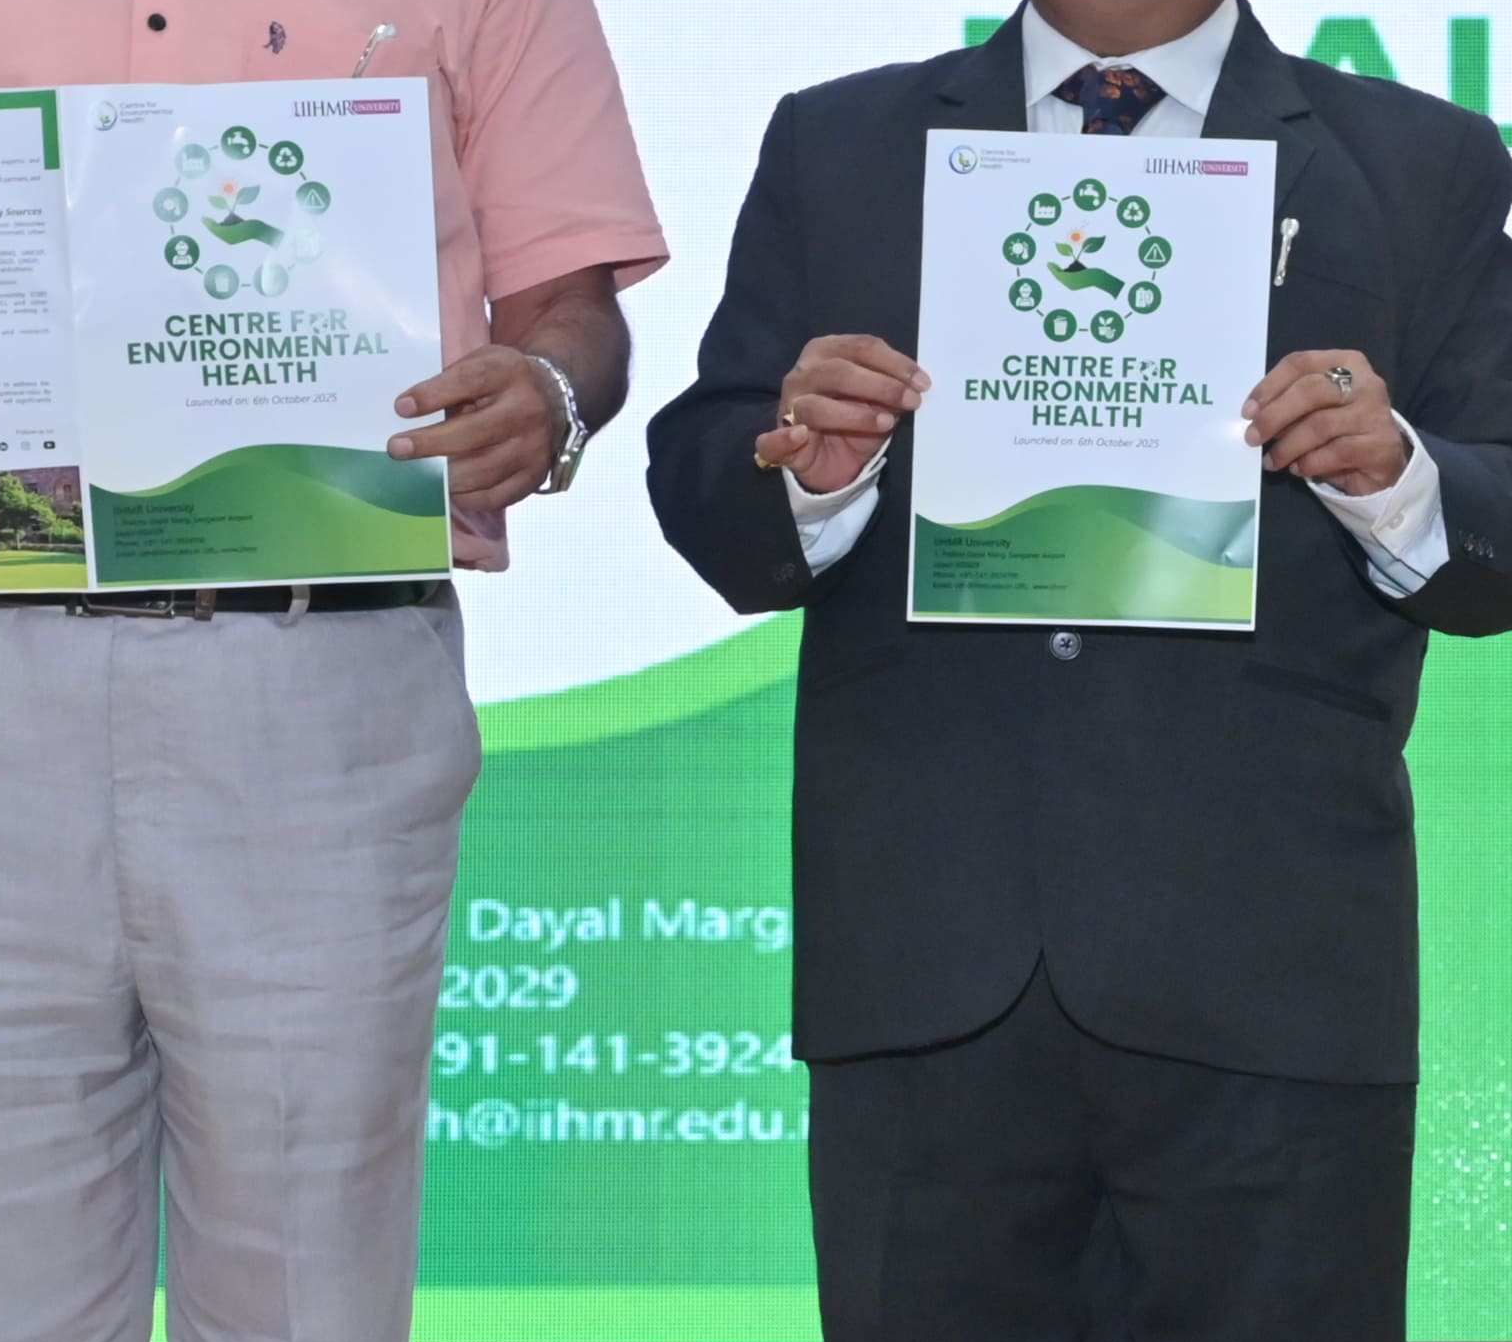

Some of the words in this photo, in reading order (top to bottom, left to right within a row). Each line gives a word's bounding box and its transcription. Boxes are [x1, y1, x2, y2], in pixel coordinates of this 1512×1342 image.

[355, 101, 399, 113] UNIVERSITY
[1203, 162, 1247, 175] UNIVERSITY
[5, 207, 43, 216] Sources
[165, 312, 283, 337] CENTRE
[127, 332, 389, 365] ENVIRONMENTAL
[202, 361, 318, 387] HEALTH
[1002, 355, 1114, 378] CENTRE
[185, 395, 232, 407] Launched
[253, 395, 269, 405] 6th
[272, 394, 310, 405] October
[312, 392, 337, 404] 2025
[964, 379, 1214, 405] ENVIRONMENTAL
[1032, 405, 1143, 428] HEALTH
[1013, 436, 1058, 445] Launched
[1078, 437, 1093, 446] 6th
[1096, 437, 1134, 447] October
[1136, 437, 1159, 449] 2025
[965, 537, 1011, 549] University
[469, 898, 622, 954] Dayal
[642, 898, 792, 953] Marg
